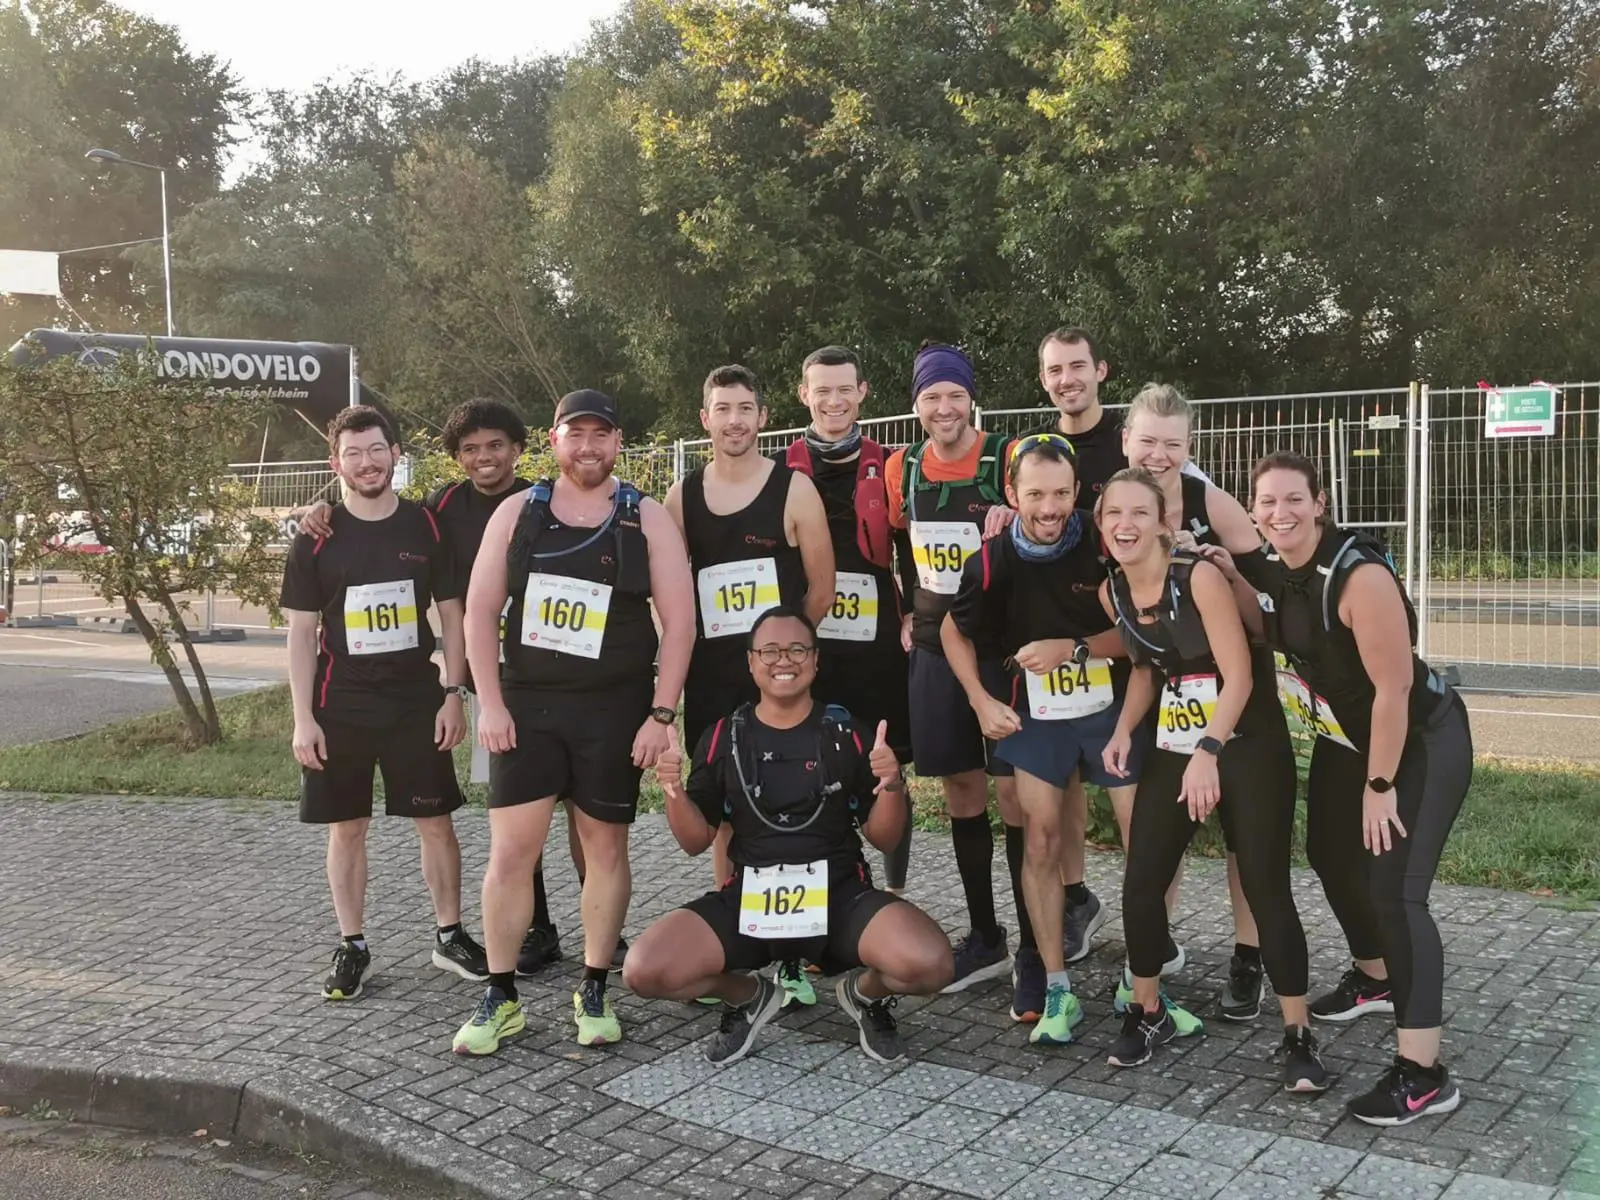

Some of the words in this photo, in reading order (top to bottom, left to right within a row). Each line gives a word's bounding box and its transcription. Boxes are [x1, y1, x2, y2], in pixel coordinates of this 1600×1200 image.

[923, 543, 962, 573] 159
[718, 580, 757, 613] 157
[824, 591, 860, 620] 63
[363, 601, 400, 633] 161
[543, 596, 587, 632] 160
[1047, 663, 1092, 697] 164
[762, 884, 806, 916] 162
